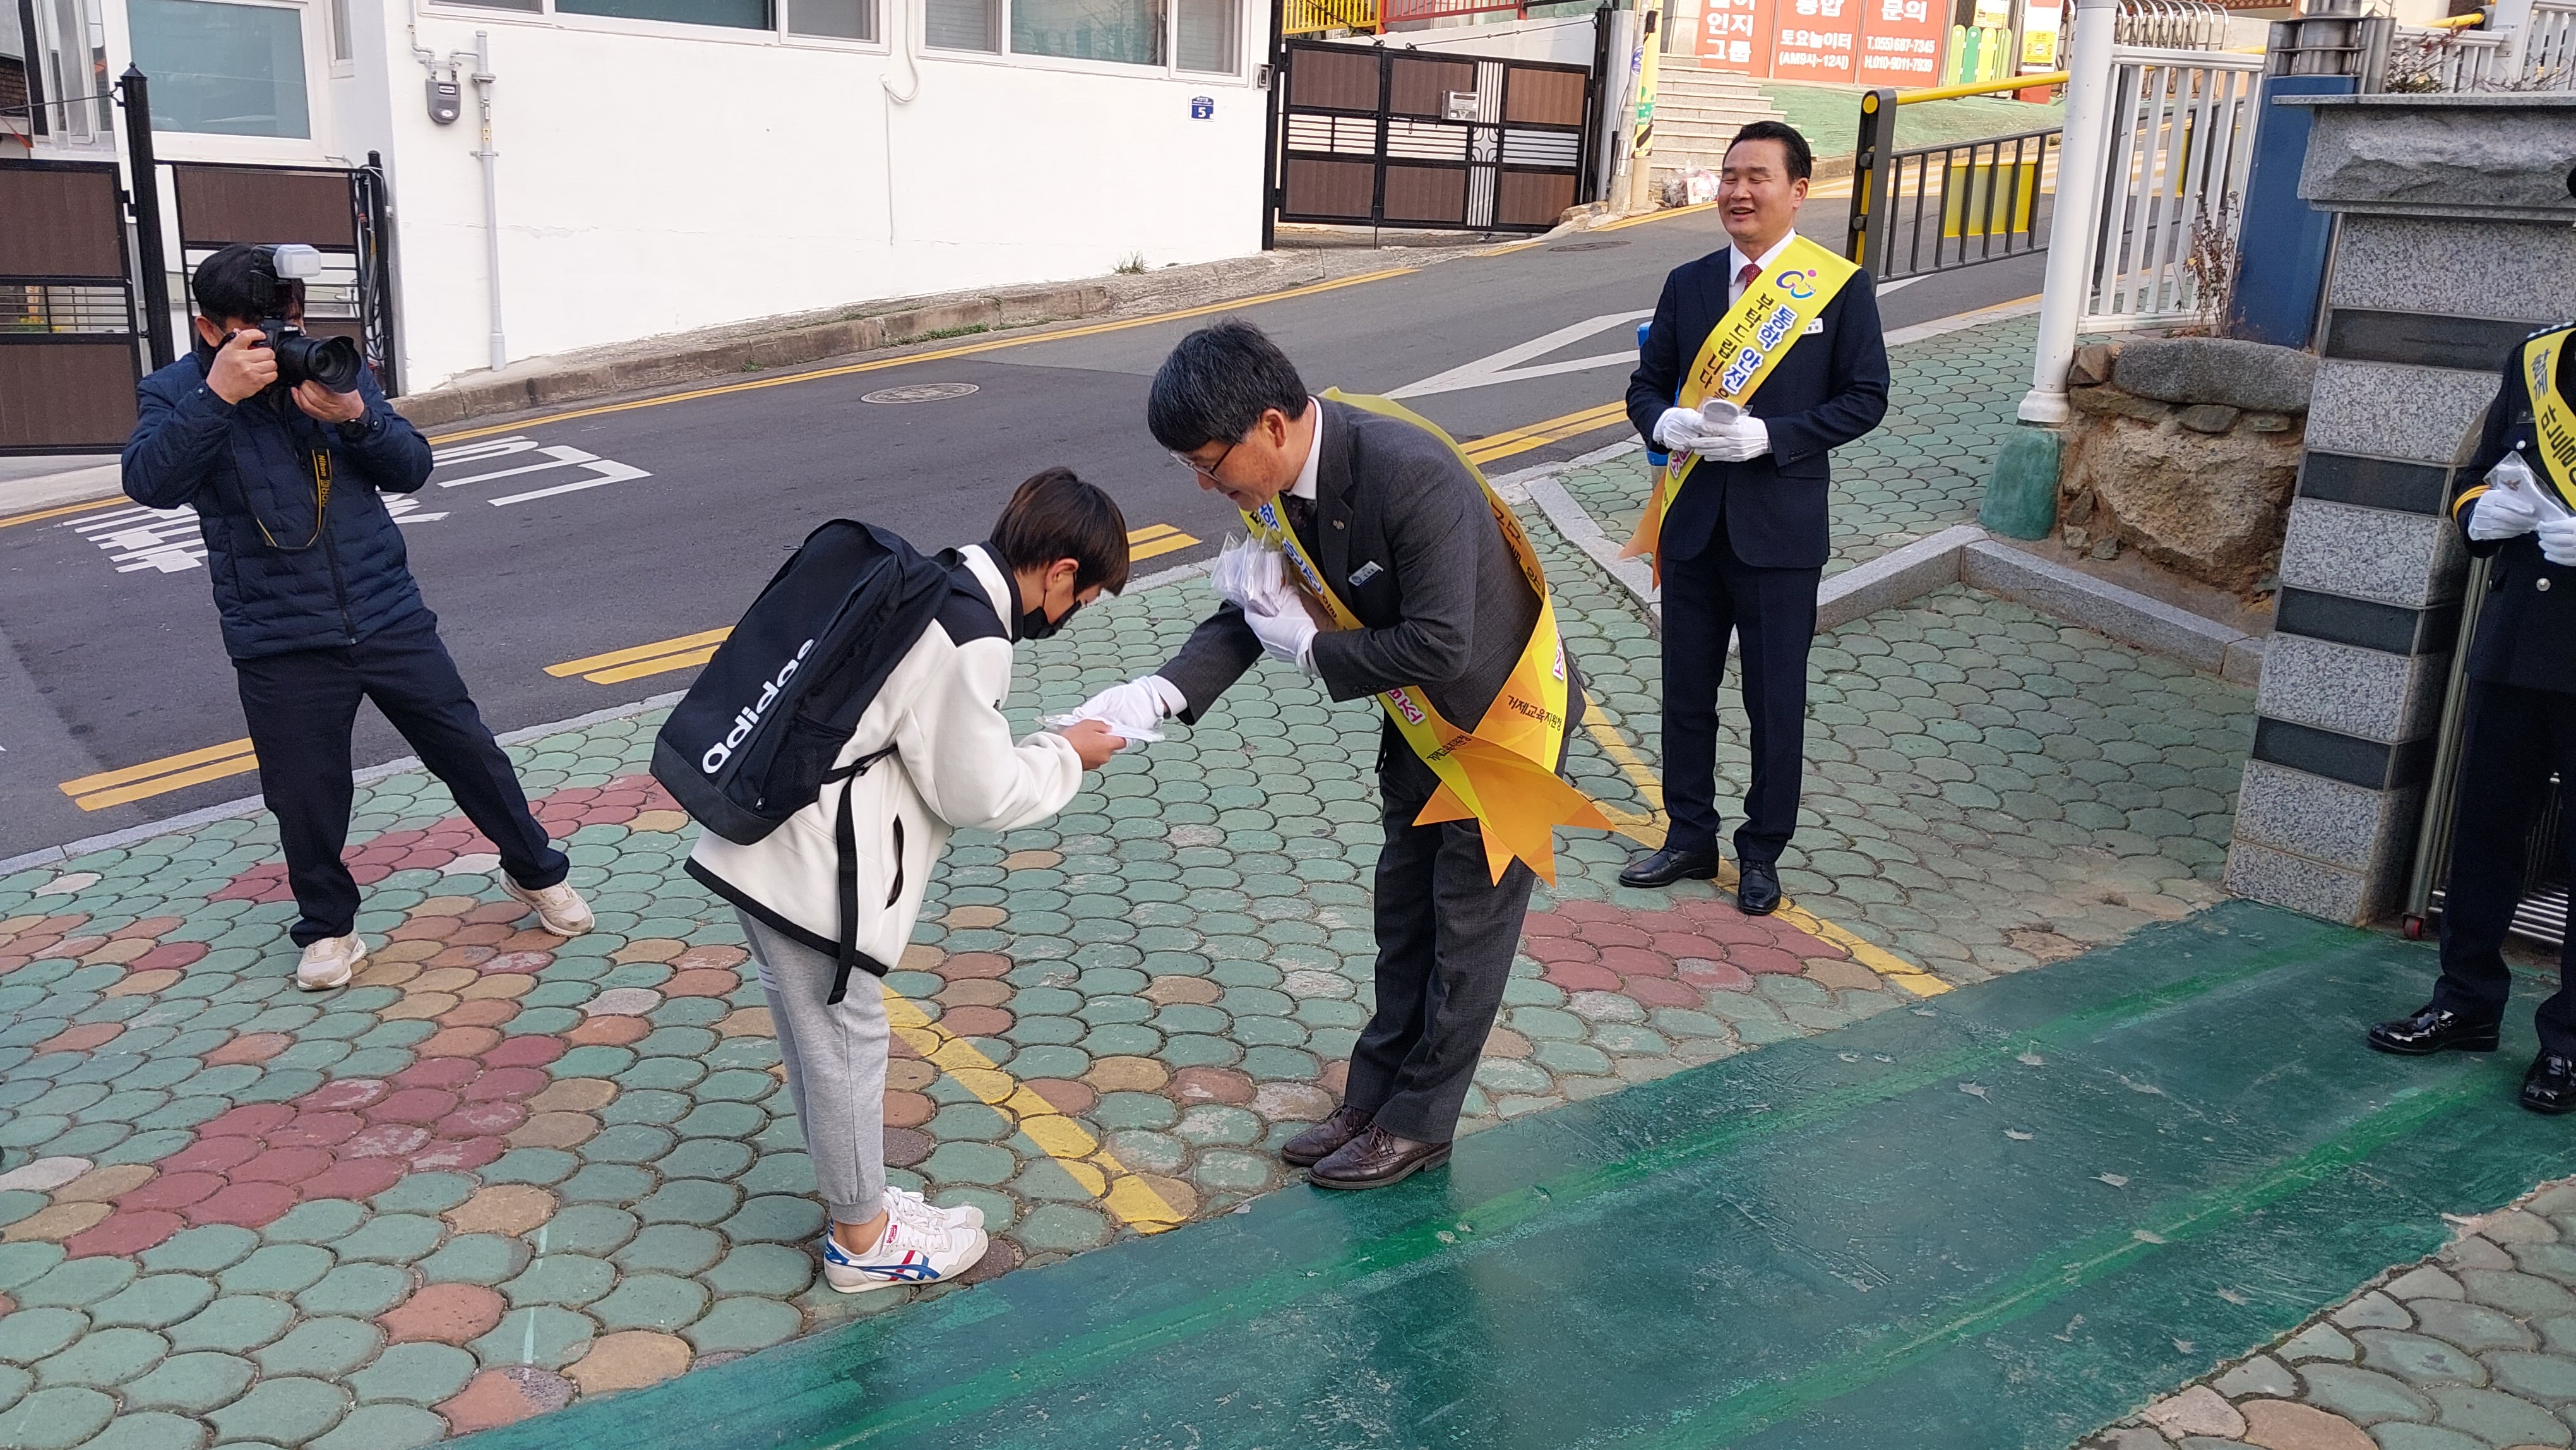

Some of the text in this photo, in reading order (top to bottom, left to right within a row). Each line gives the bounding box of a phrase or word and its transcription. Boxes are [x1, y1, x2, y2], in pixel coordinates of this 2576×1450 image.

[1881, 0, 1928, 23] 문의
[1707, 12, 1754, 37] 인지
[1704, 39, 1752, 63] 그룹
[1780, 29, 1852, 51] 토요놀이터
[1198, 107, 1207, 117] 5
[1759, 306, 1795, 349] 통학
[1699, 292, 1775, 390] 부탁드립니다
[2531, 348, 2552, 402] 함께
[318, 455, 327, 477] Nikon
[1507, 694, 1563, 732] 거제교육지원청
